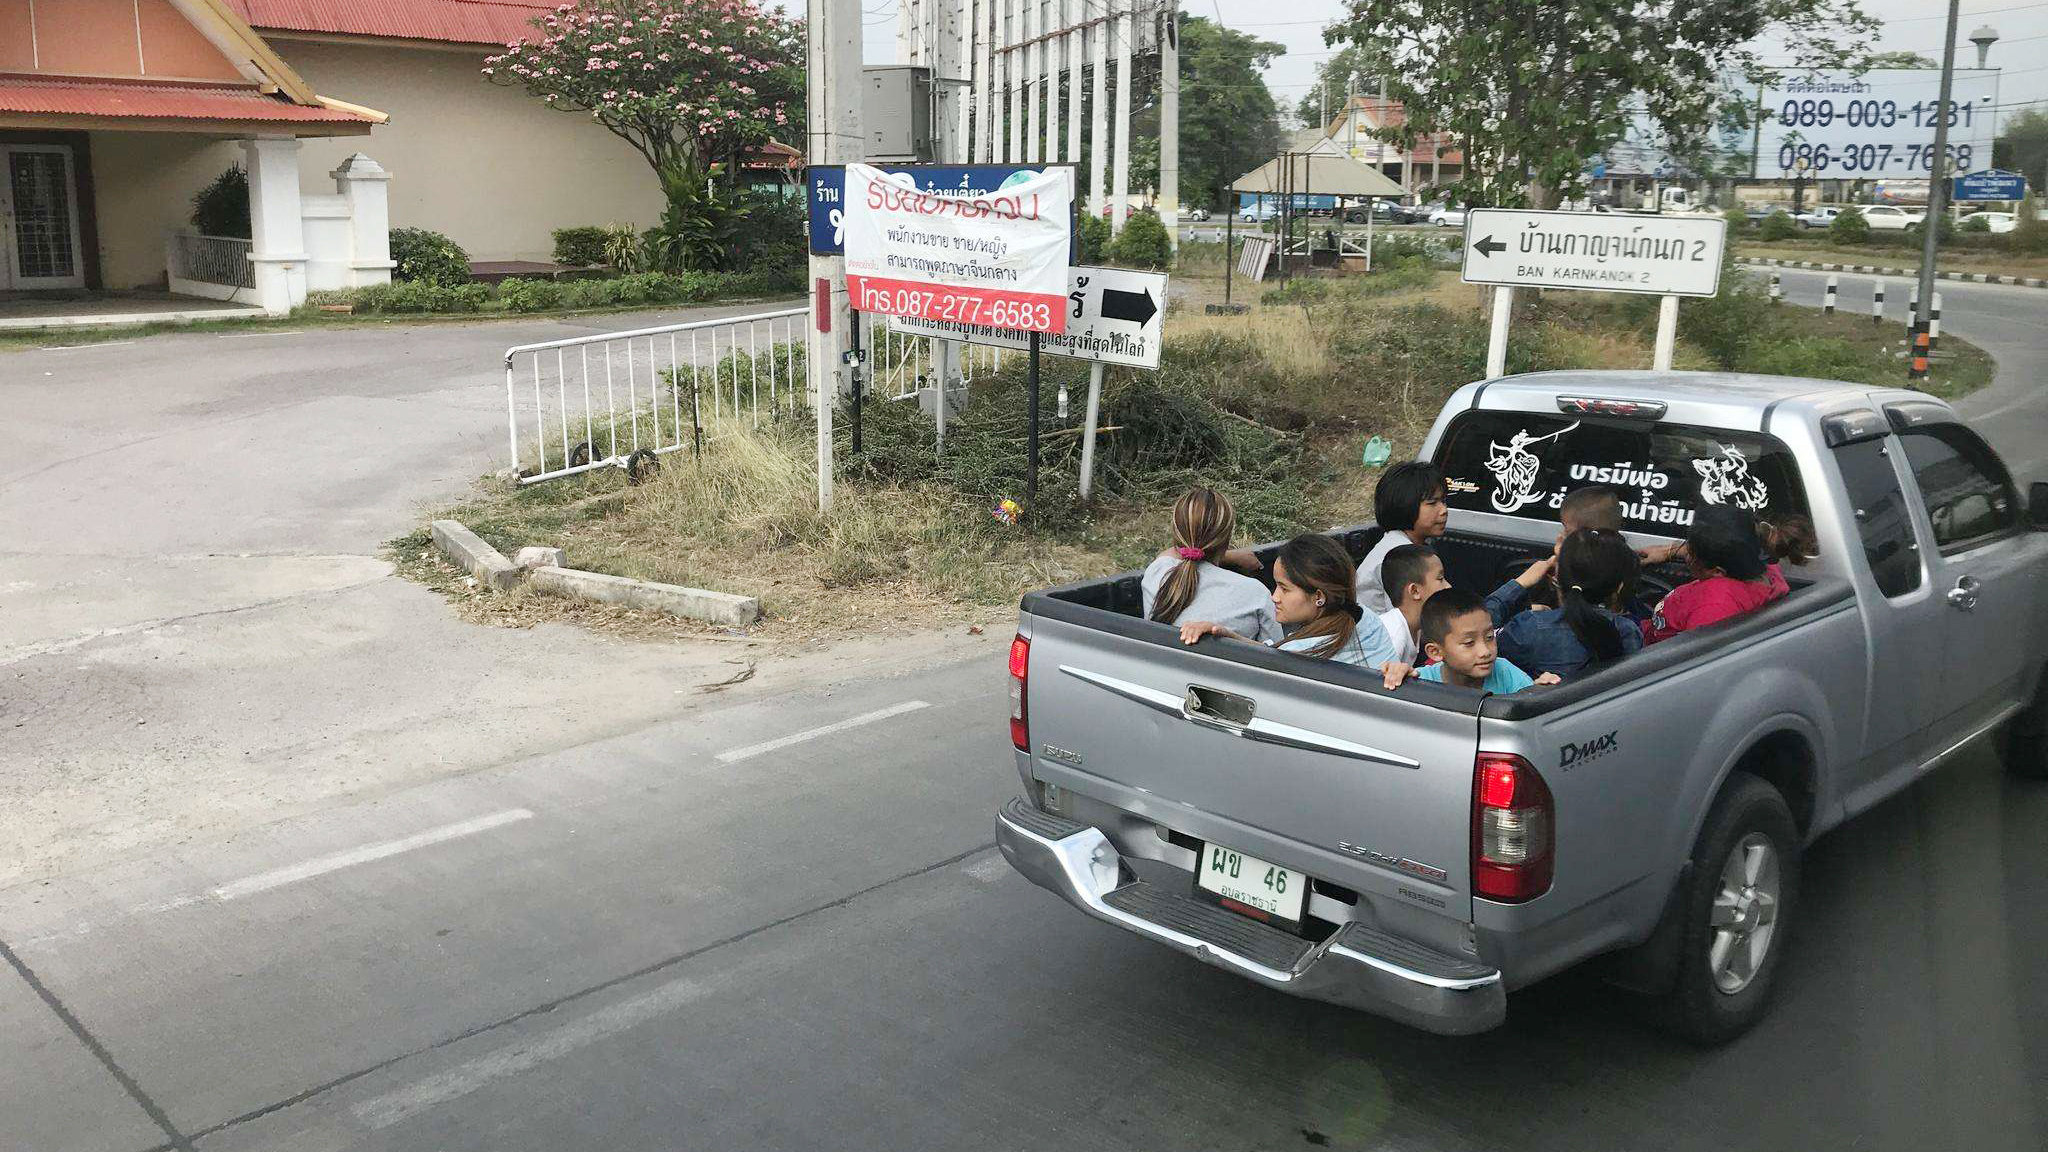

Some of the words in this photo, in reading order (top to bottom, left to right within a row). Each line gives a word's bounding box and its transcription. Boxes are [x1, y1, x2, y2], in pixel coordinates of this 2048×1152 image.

[815, 179, 839, 203] ร้าน
[887, 225, 950, 248] พนักงานขาย
[1520, 221, 1685, 263] บ้านกาญจน์กนก
[1691, 239, 1706, 262] 2
[886, 253, 1018, 282] สามารถพูดภาษาจีนกลาง
[1517, 265, 1545, 278] BAN
[1553, 266, 1636, 283] KARNKANOK
[1640, 272, 1651, 284] 2
[1570, 461, 1669, 490] บารมีพ่อ
[1263, 866, 1288, 894] 46
[1221, 884, 1278, 913] อบลราชธานี
